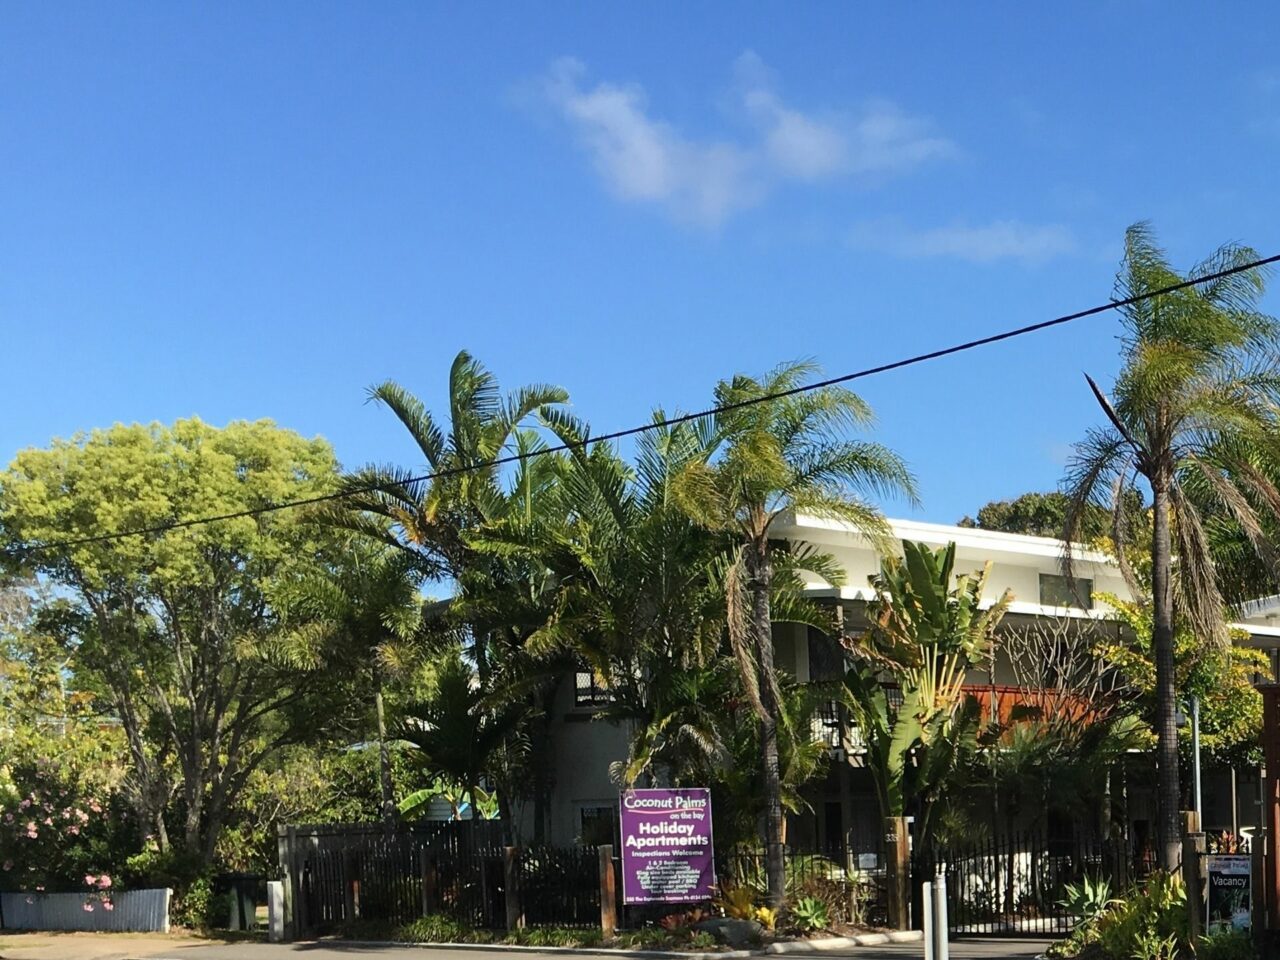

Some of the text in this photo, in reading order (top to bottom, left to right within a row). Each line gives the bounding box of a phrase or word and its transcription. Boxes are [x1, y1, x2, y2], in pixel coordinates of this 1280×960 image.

[624, 796, 706, 810] Coconut Palms
[639, 822, 694, 836] Holiday
[626, 834, 708, 850] Apartments
[1212, 876, 1246, 888] Vacancy
